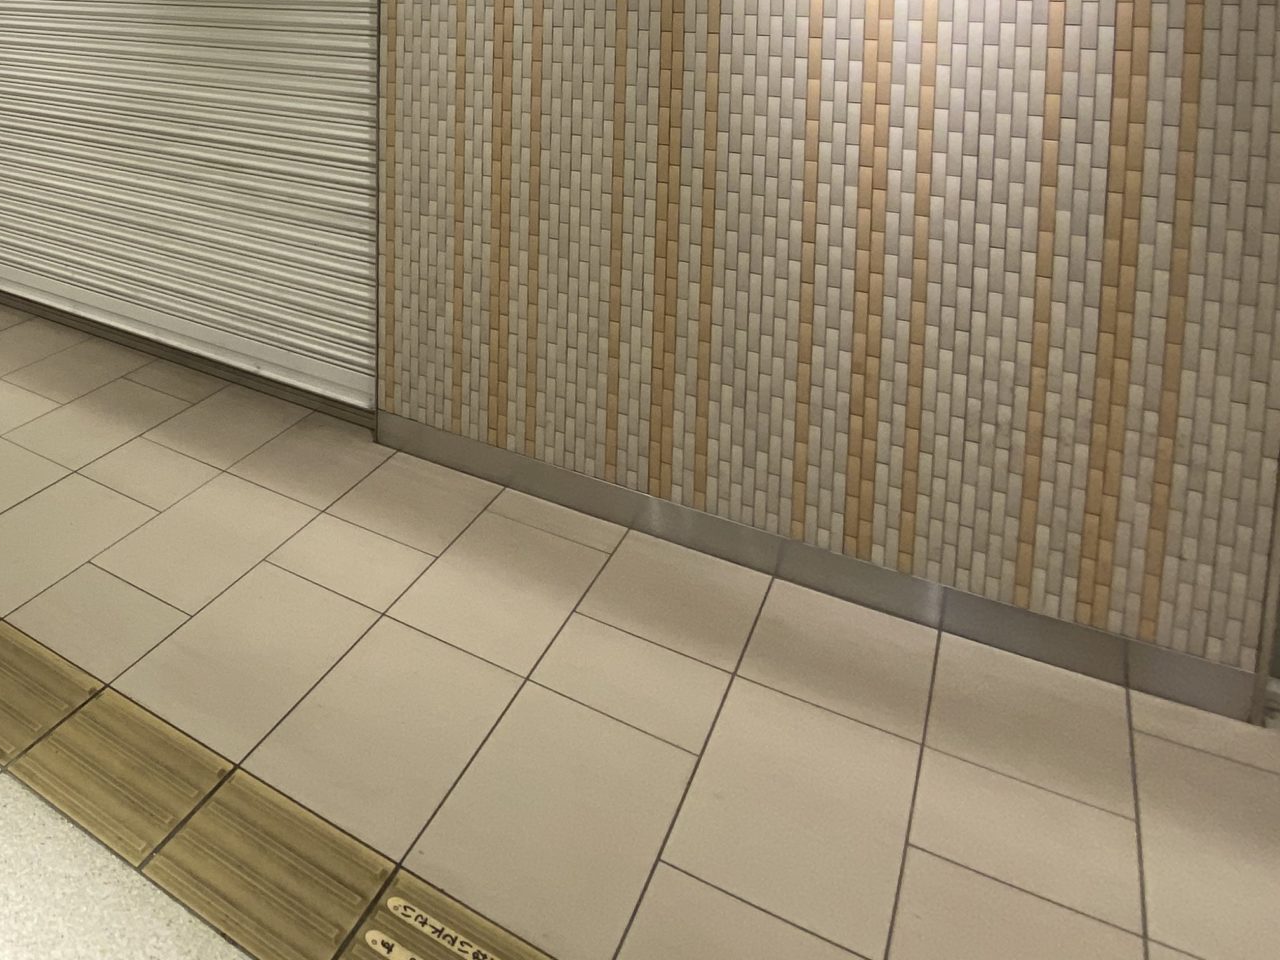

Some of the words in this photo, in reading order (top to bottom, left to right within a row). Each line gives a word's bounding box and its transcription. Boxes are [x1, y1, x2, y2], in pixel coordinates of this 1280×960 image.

[393, 903, 494, 960] ないで下さい。
